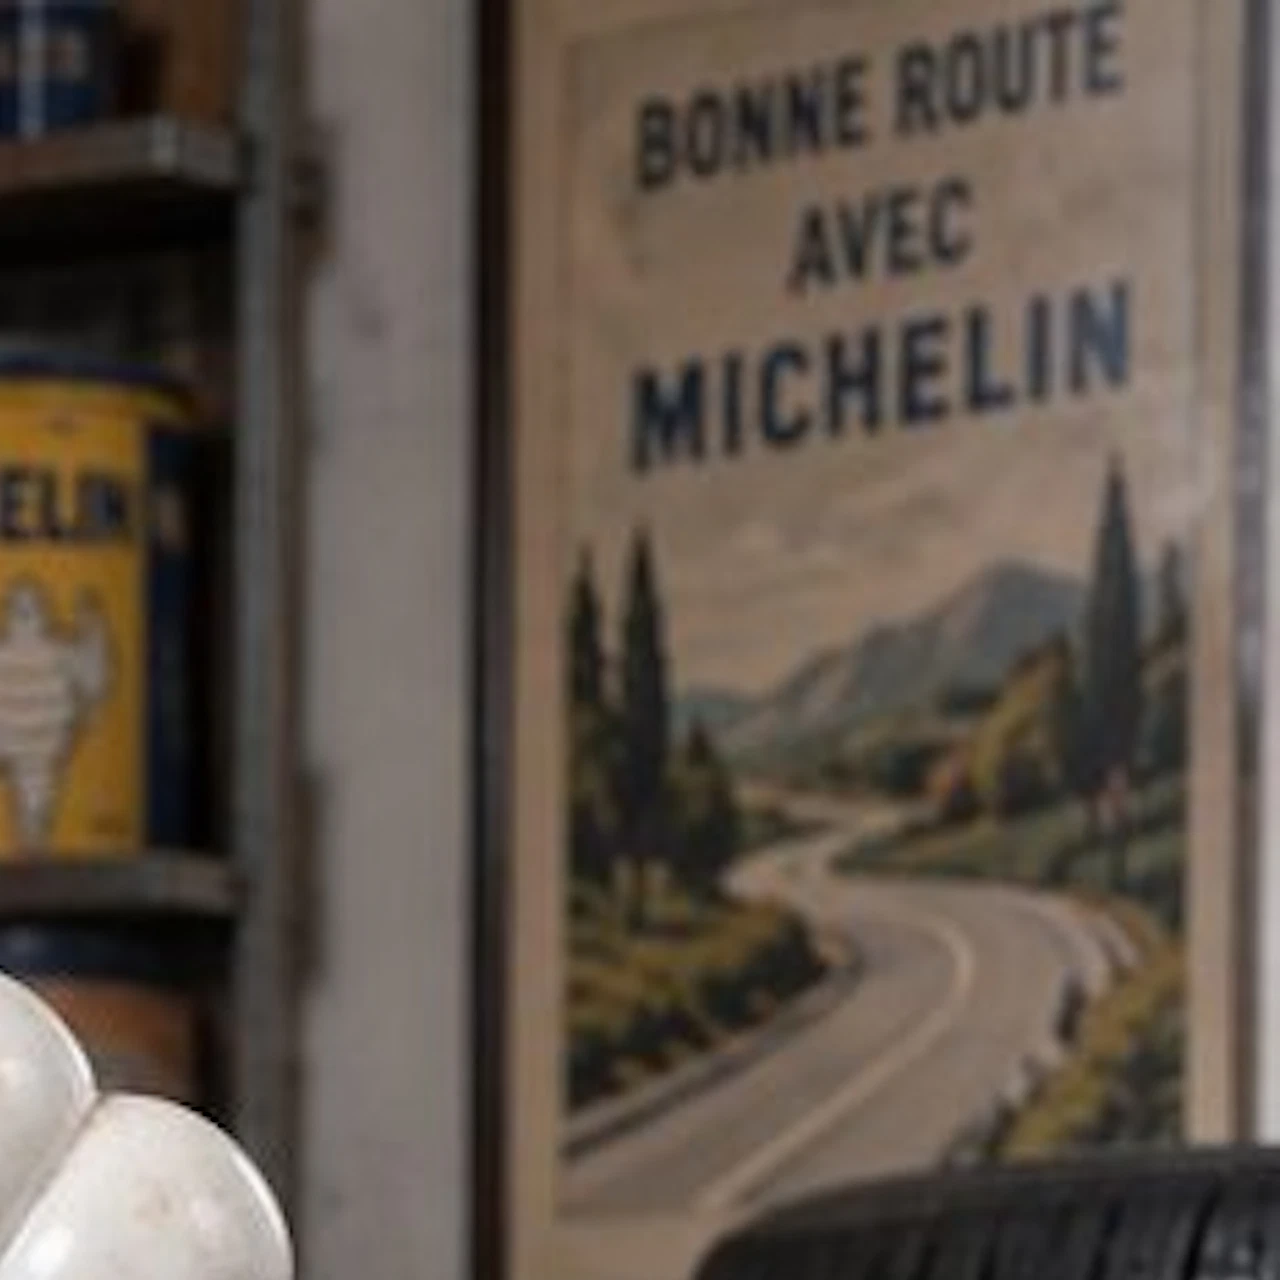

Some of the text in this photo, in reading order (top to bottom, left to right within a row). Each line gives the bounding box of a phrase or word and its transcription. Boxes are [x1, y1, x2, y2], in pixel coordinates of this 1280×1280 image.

[637, 3, 1122, 190] BONNE ROUTE
[788, 179, 972, 293] AVEC
[630, 282, 1133, 472] MICHELIN
